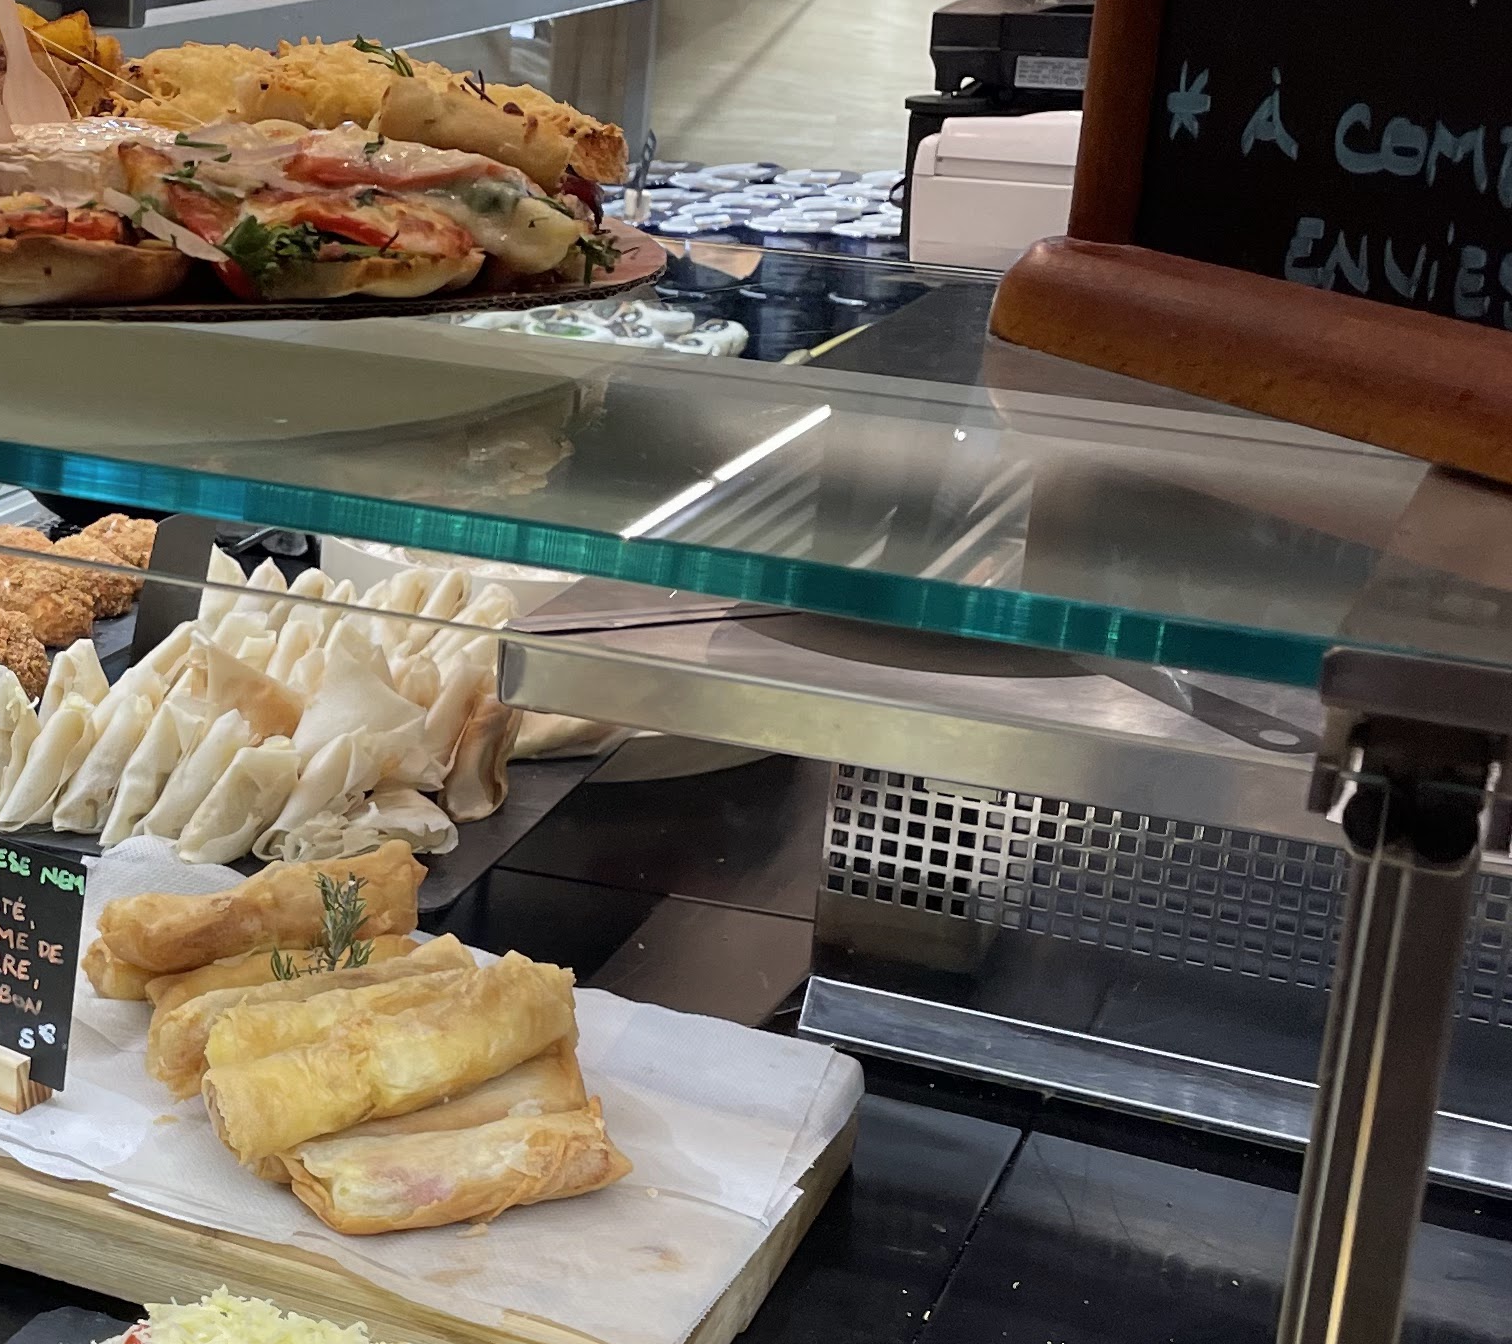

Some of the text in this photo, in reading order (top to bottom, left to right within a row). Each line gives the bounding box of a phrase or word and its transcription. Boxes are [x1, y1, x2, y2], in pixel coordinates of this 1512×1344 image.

[1334, 102, 1512, 209] COM
[39, 866, 85, 896] NEM
[38, 940, 64, 965] DE
